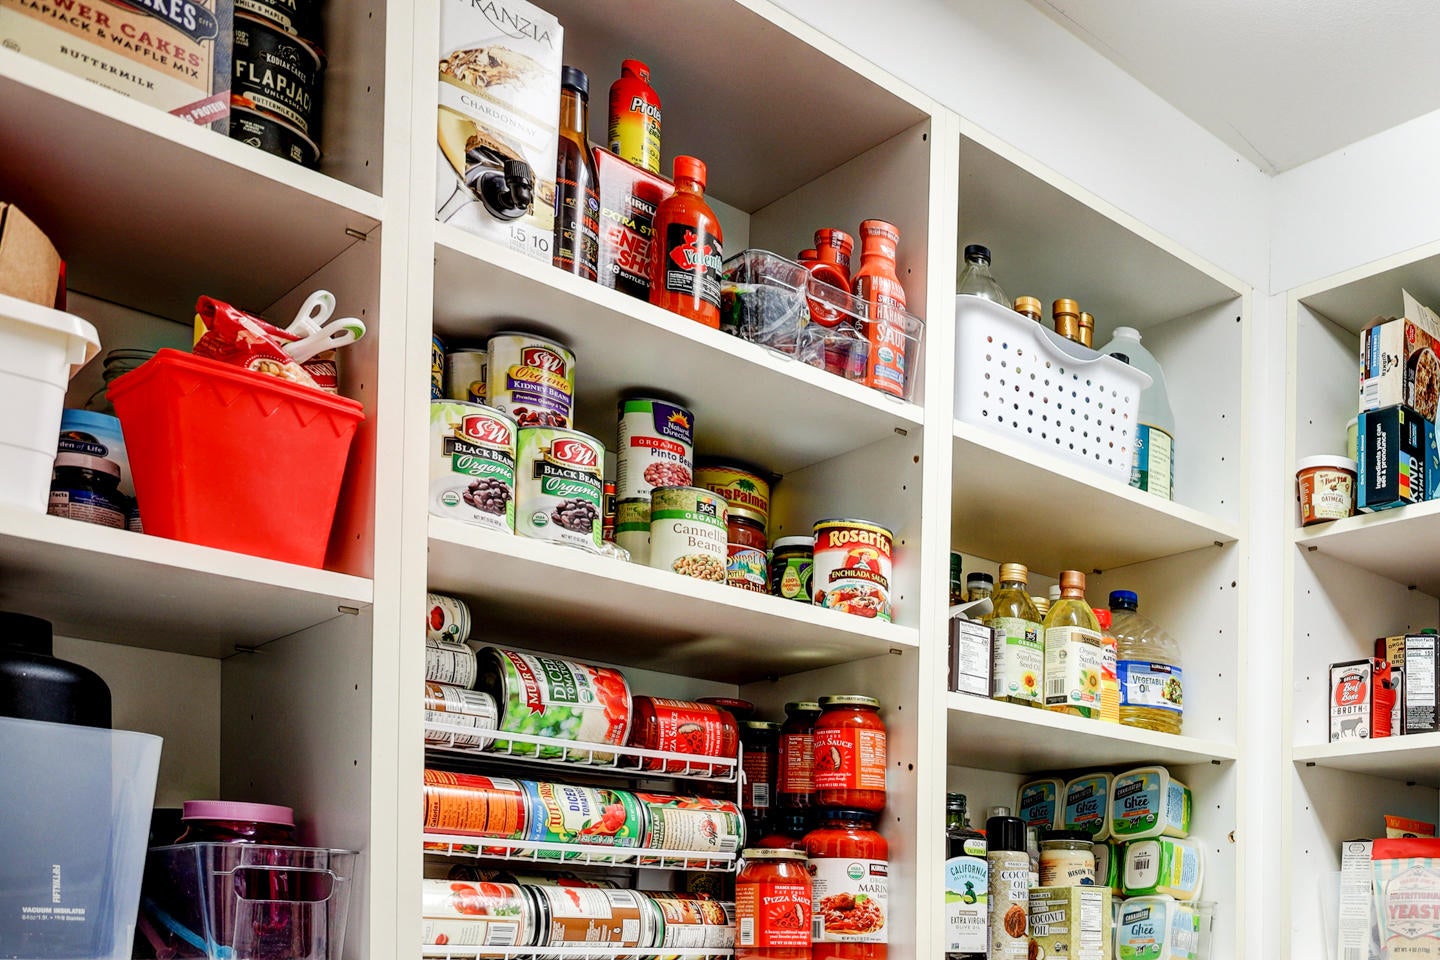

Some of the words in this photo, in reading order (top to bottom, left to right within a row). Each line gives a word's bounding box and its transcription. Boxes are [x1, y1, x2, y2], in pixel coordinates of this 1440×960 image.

[265, 9, 284, 23] MAPLE
[120, 23, 201, 67] CAKES
[111, 34, 168, 65] WAFFLE
[173, 62, 198, 79] MIX
[266, 53, 290, 70] KODIAK
[60, 46, 154, 90] BUTTERMILK
[461, 95, 536, 137] CHARDONNAY
[601, 208, 636, 229] EXTRA
[606, 264, 620, 275] 48
[515, 368, 569, 391] Organic
[513, 381, 549, 395] KIDNEY
[549, 388, 570, 402] BEANS
[455, 443, 490, 457] BLACK
[639, 438, 683, 453] ORGANIC
[650, 448, 677, 461] Pinto
[457, 455, 512, 479] Organic
[544, 466, 577, 479] BLACK
[1409, 456, 1418, 502] KIND
[545, 477, 599, 499] Organic
[685, 513, 725, 527] ORGANIC
[688, 536, 721, 554] Beans
[829, 529, 890, 556] Rosarita
[832, 570, 870, 581] ENCHILADA
[871, 574, 887, 587] SAUCE
[1132, 675, 1164, 685] VEGETABLE
[1344, 682, 1360, 691] Beef
[1342, 692, 1358, 700] Bone
[1337, 706, 1363, 714] BROTH
[827, 739, 852, 748] SAUCE
[563, 788, 580, 812] DICED
[1124, 795, 1150, 808] Ghee
[950, 863, 987, 878] CALIFORNIA
[764, 895, 790, 904] PIZZA
[791, 895, 810, 905] SAUCE
[951, 916, 967, 924] EXTRA
[969, 916, 985, 924] VIRGIN
[1030, 911, 1064, 925] COCONUT
[1035, 925, 1048, 935] OIL
[1131, 923, 1154, 936] Ghee
